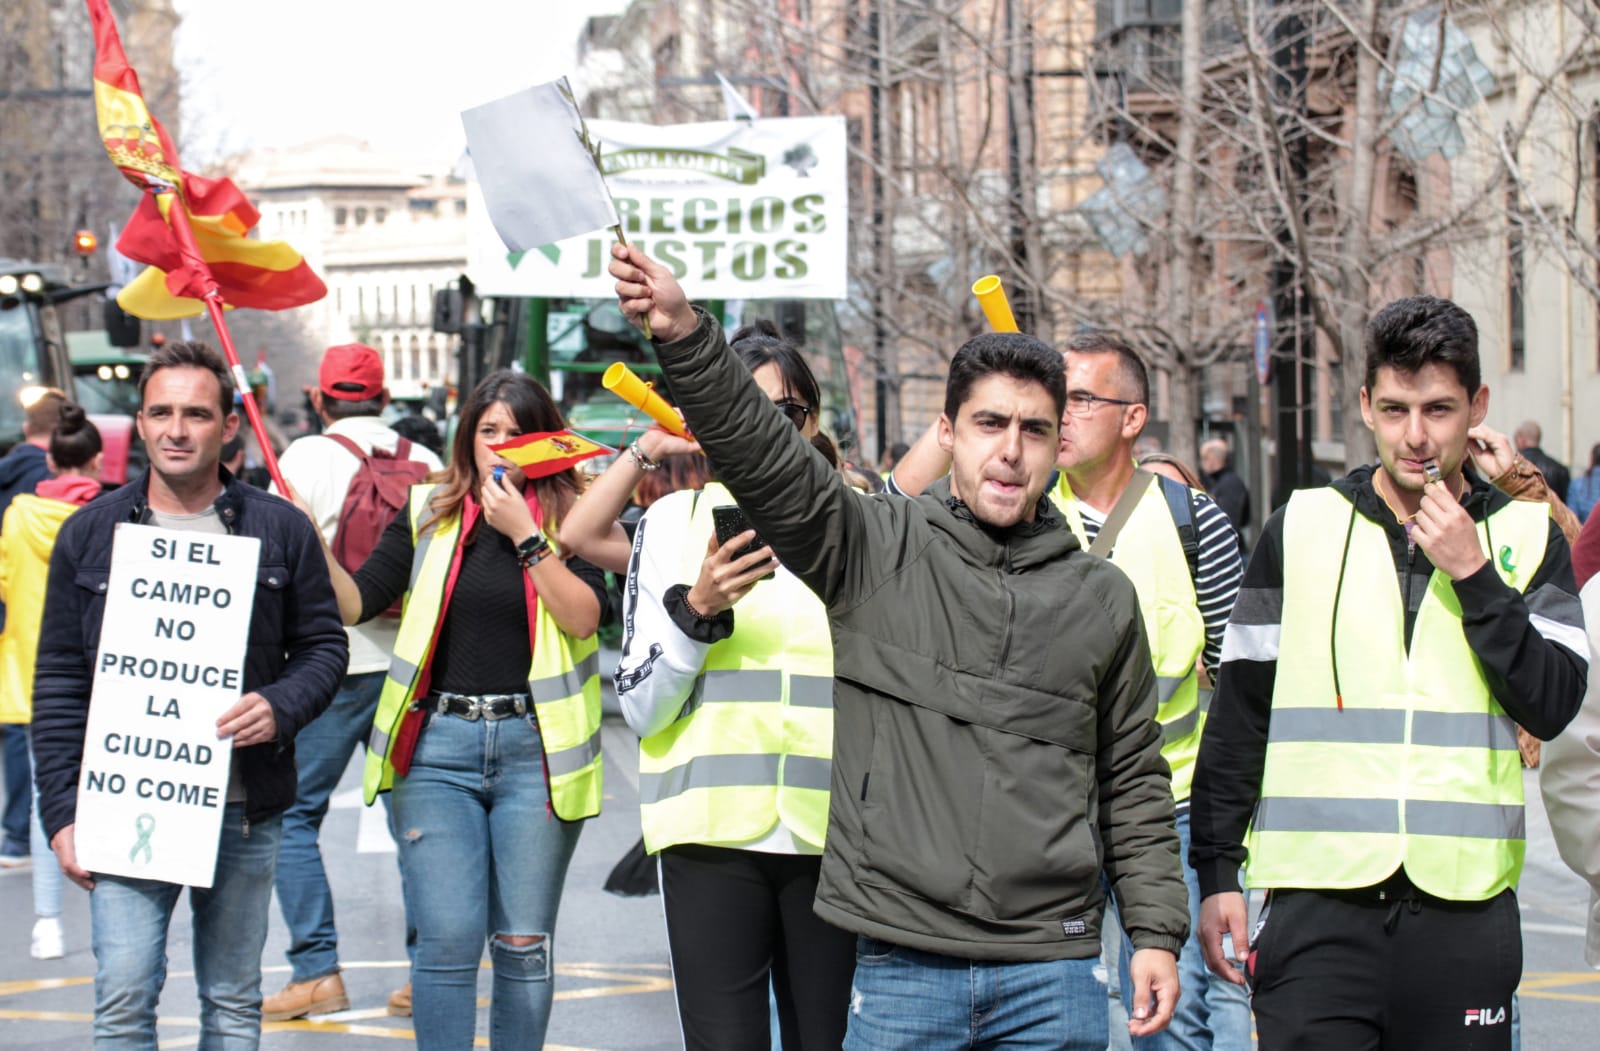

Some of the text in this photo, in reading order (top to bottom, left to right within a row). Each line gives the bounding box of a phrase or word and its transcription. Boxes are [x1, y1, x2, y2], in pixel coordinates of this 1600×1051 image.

[607, 194, 827, 234] RECIOS
[151, 537, 221, 566] SI EL
[634, 530, 643, 553] NIKE
[131, 577, 232, 609] CAMPO
[629, 571, 639, 596] NIKE
[154, 617, 196, 642] NO
[626, 613, 634, 638] NIKE
[101, 652, 239, 690] PRODUCE
[146, 695, 181, 720] LA
[104, 732, 213, 766] CIUDAD
[88, 770, 220, 809] NO COME
[1465, 1006, 1506, 1026] FILA
